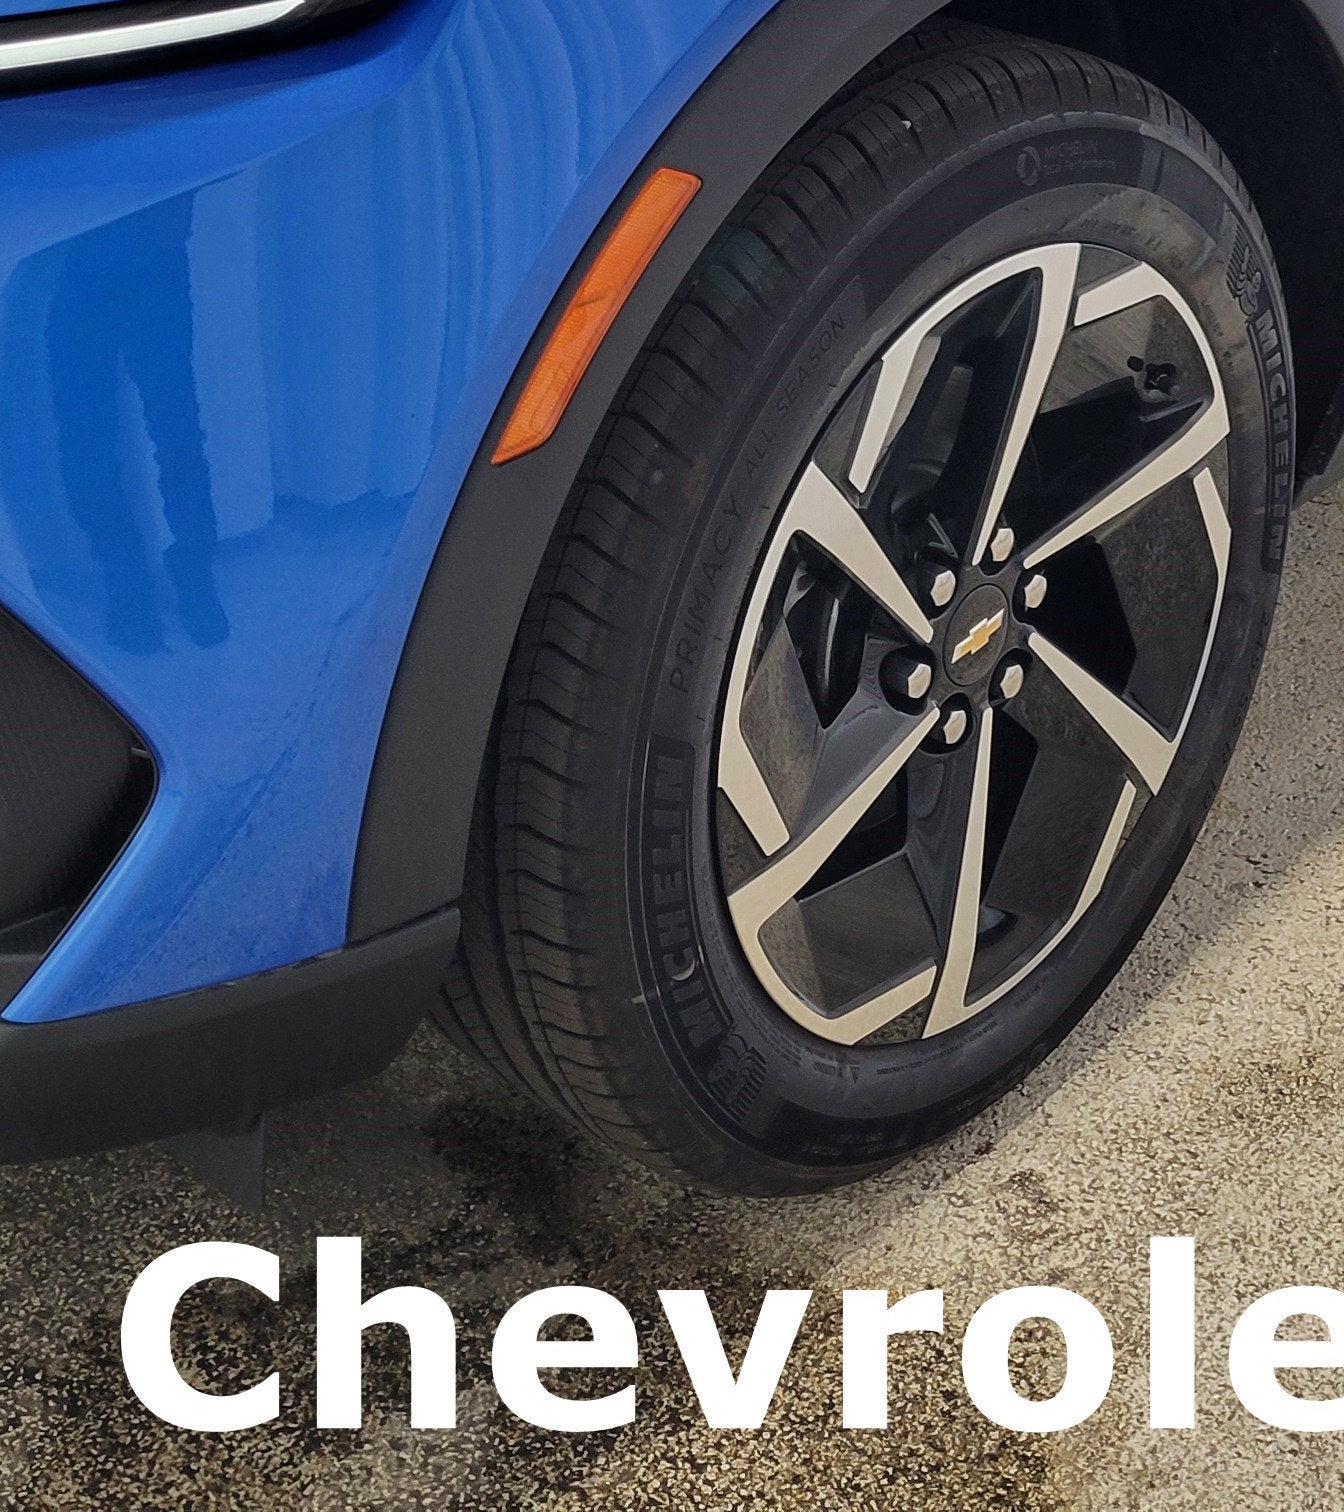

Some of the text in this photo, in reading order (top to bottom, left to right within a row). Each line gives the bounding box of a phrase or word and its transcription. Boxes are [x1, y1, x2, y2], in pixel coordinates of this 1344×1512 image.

[669, 310, 847, 694] PRIMACY ALL SEASON
[1256, 308, 1290, 560] MICHELIN
[651, 754, 724, 1050] MICHELIN
